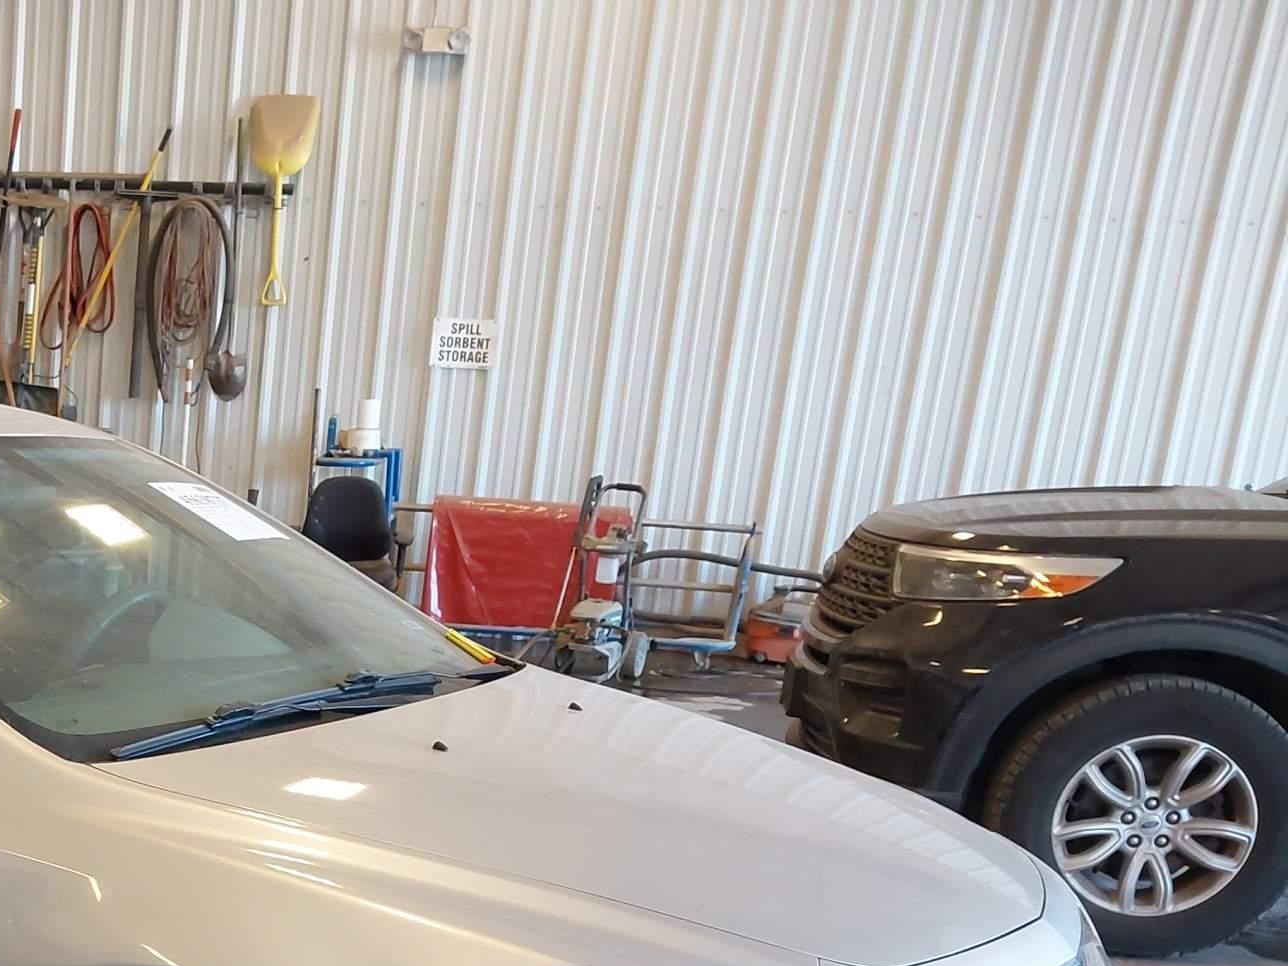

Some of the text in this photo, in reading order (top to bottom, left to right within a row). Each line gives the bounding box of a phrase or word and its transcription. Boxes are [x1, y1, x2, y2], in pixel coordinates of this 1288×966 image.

[451, 322, 482, 335] SPILL
[439, 336, 491, 350] SORBENT
[438, 350, 489, 363] STORAGE
